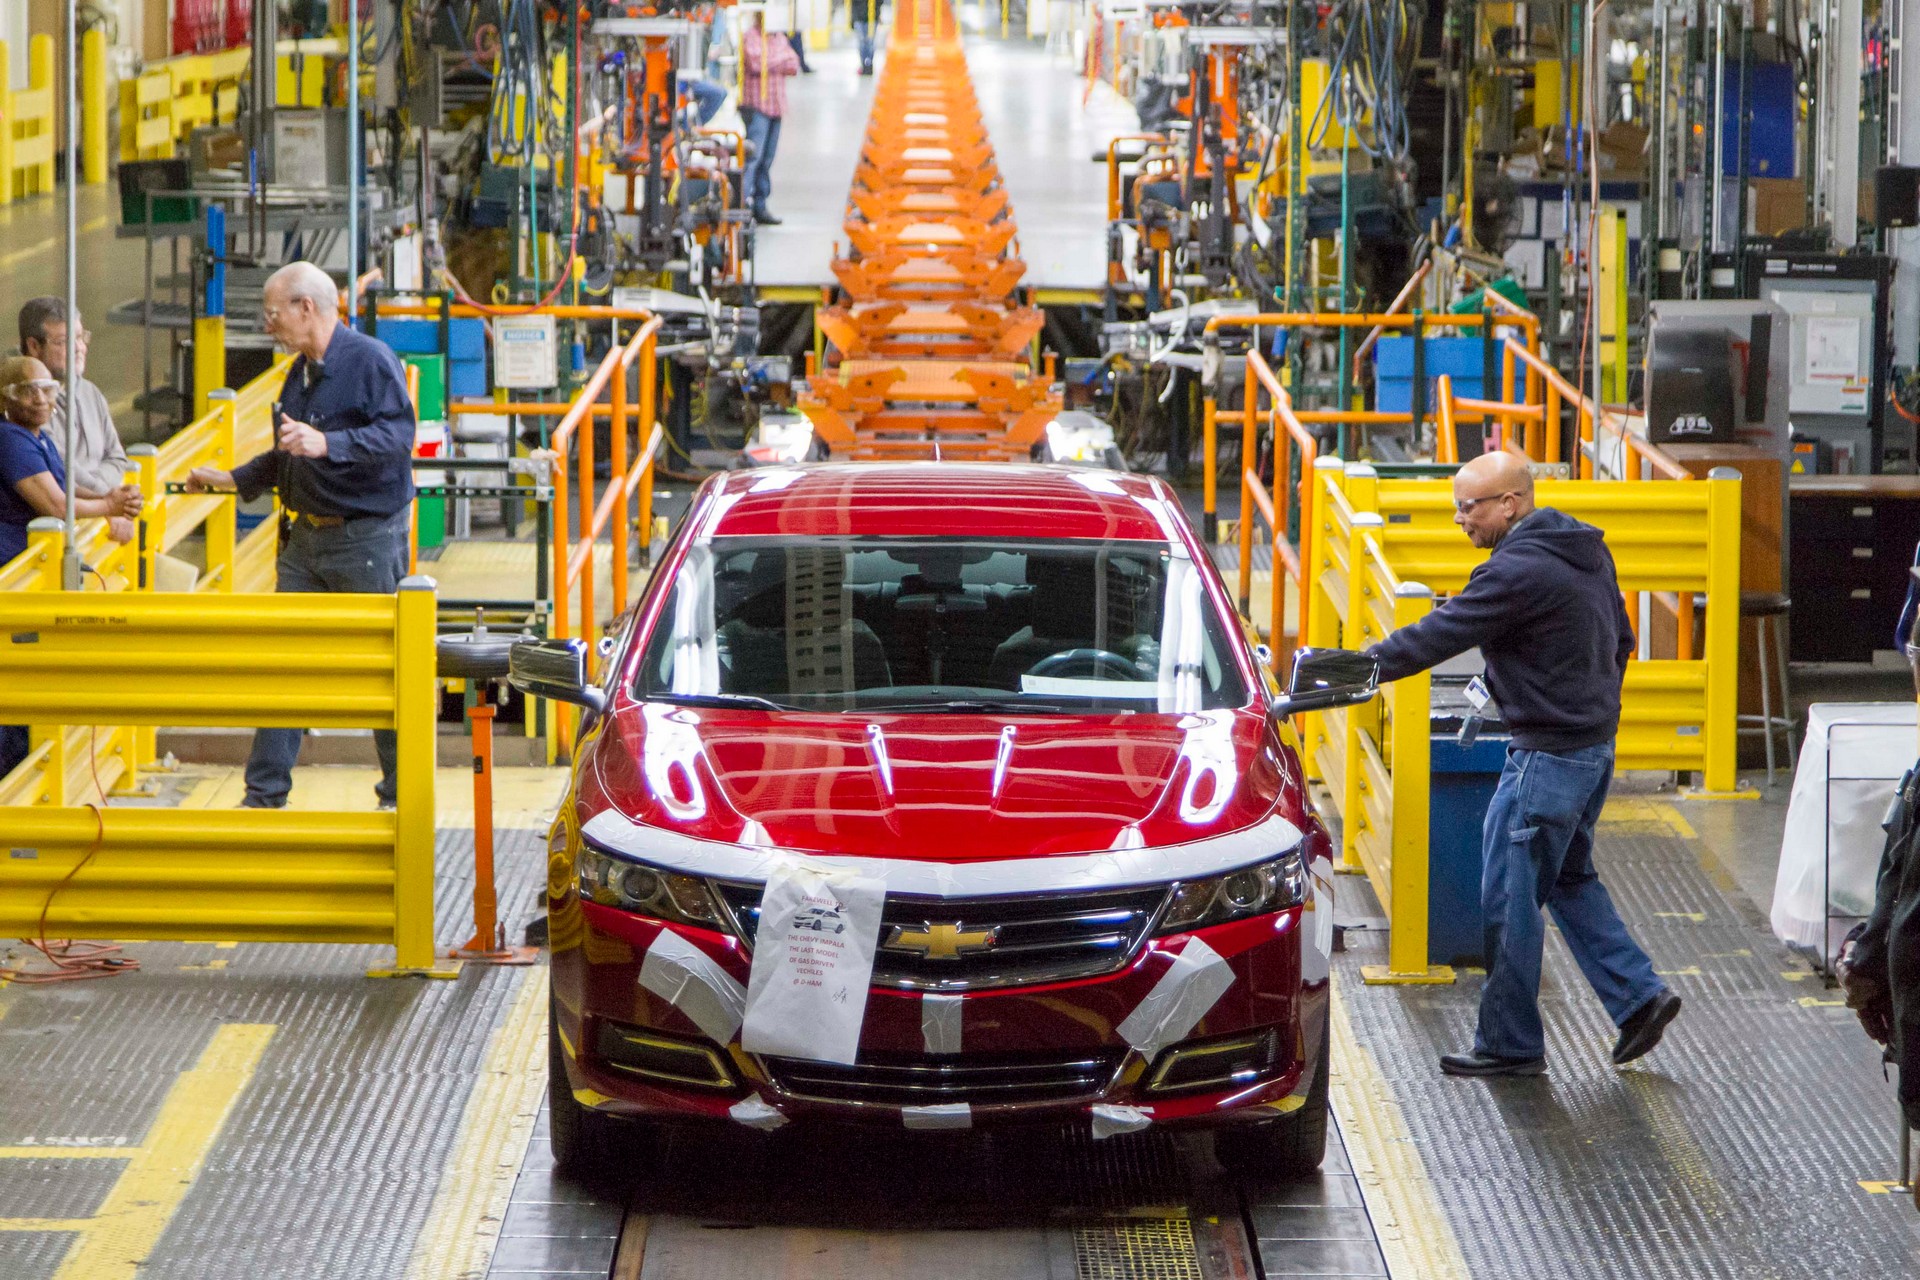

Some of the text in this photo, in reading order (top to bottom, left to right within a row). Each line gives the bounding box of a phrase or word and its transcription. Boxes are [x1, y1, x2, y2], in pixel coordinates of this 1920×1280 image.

[801, 896, 833, 906] FAREWELL
[788, 934, 845, 948] THE CHEVY IMPALA
[789, 945, 839, 958] THE LAST MODEL
[798, 957, 810, 965] GAS
[810, 958, 834, 968] DRIVEN
